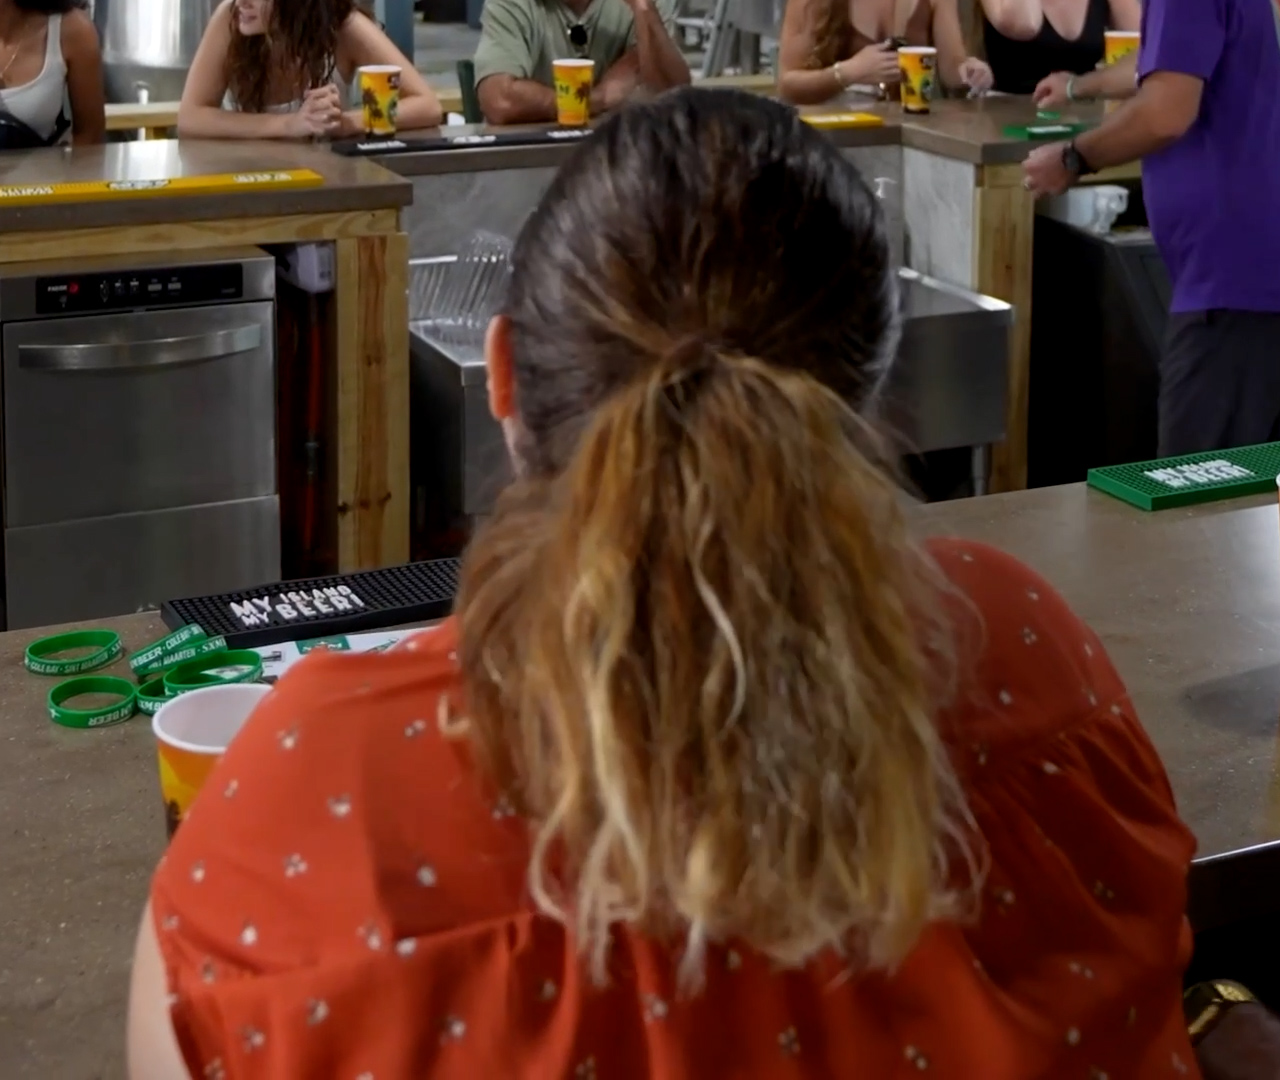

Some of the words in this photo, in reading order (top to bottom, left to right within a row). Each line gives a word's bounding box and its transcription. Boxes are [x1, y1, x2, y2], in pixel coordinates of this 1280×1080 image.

[230, 596, 272, 618] MY
[280, 585, 352, 604] ISLAND
[241, 611, 270, 626] MY
[275, 593, 365, 620] BEER!
[46, 664, 60, 673] BAY
[138, 646, 163, 665] BEER
